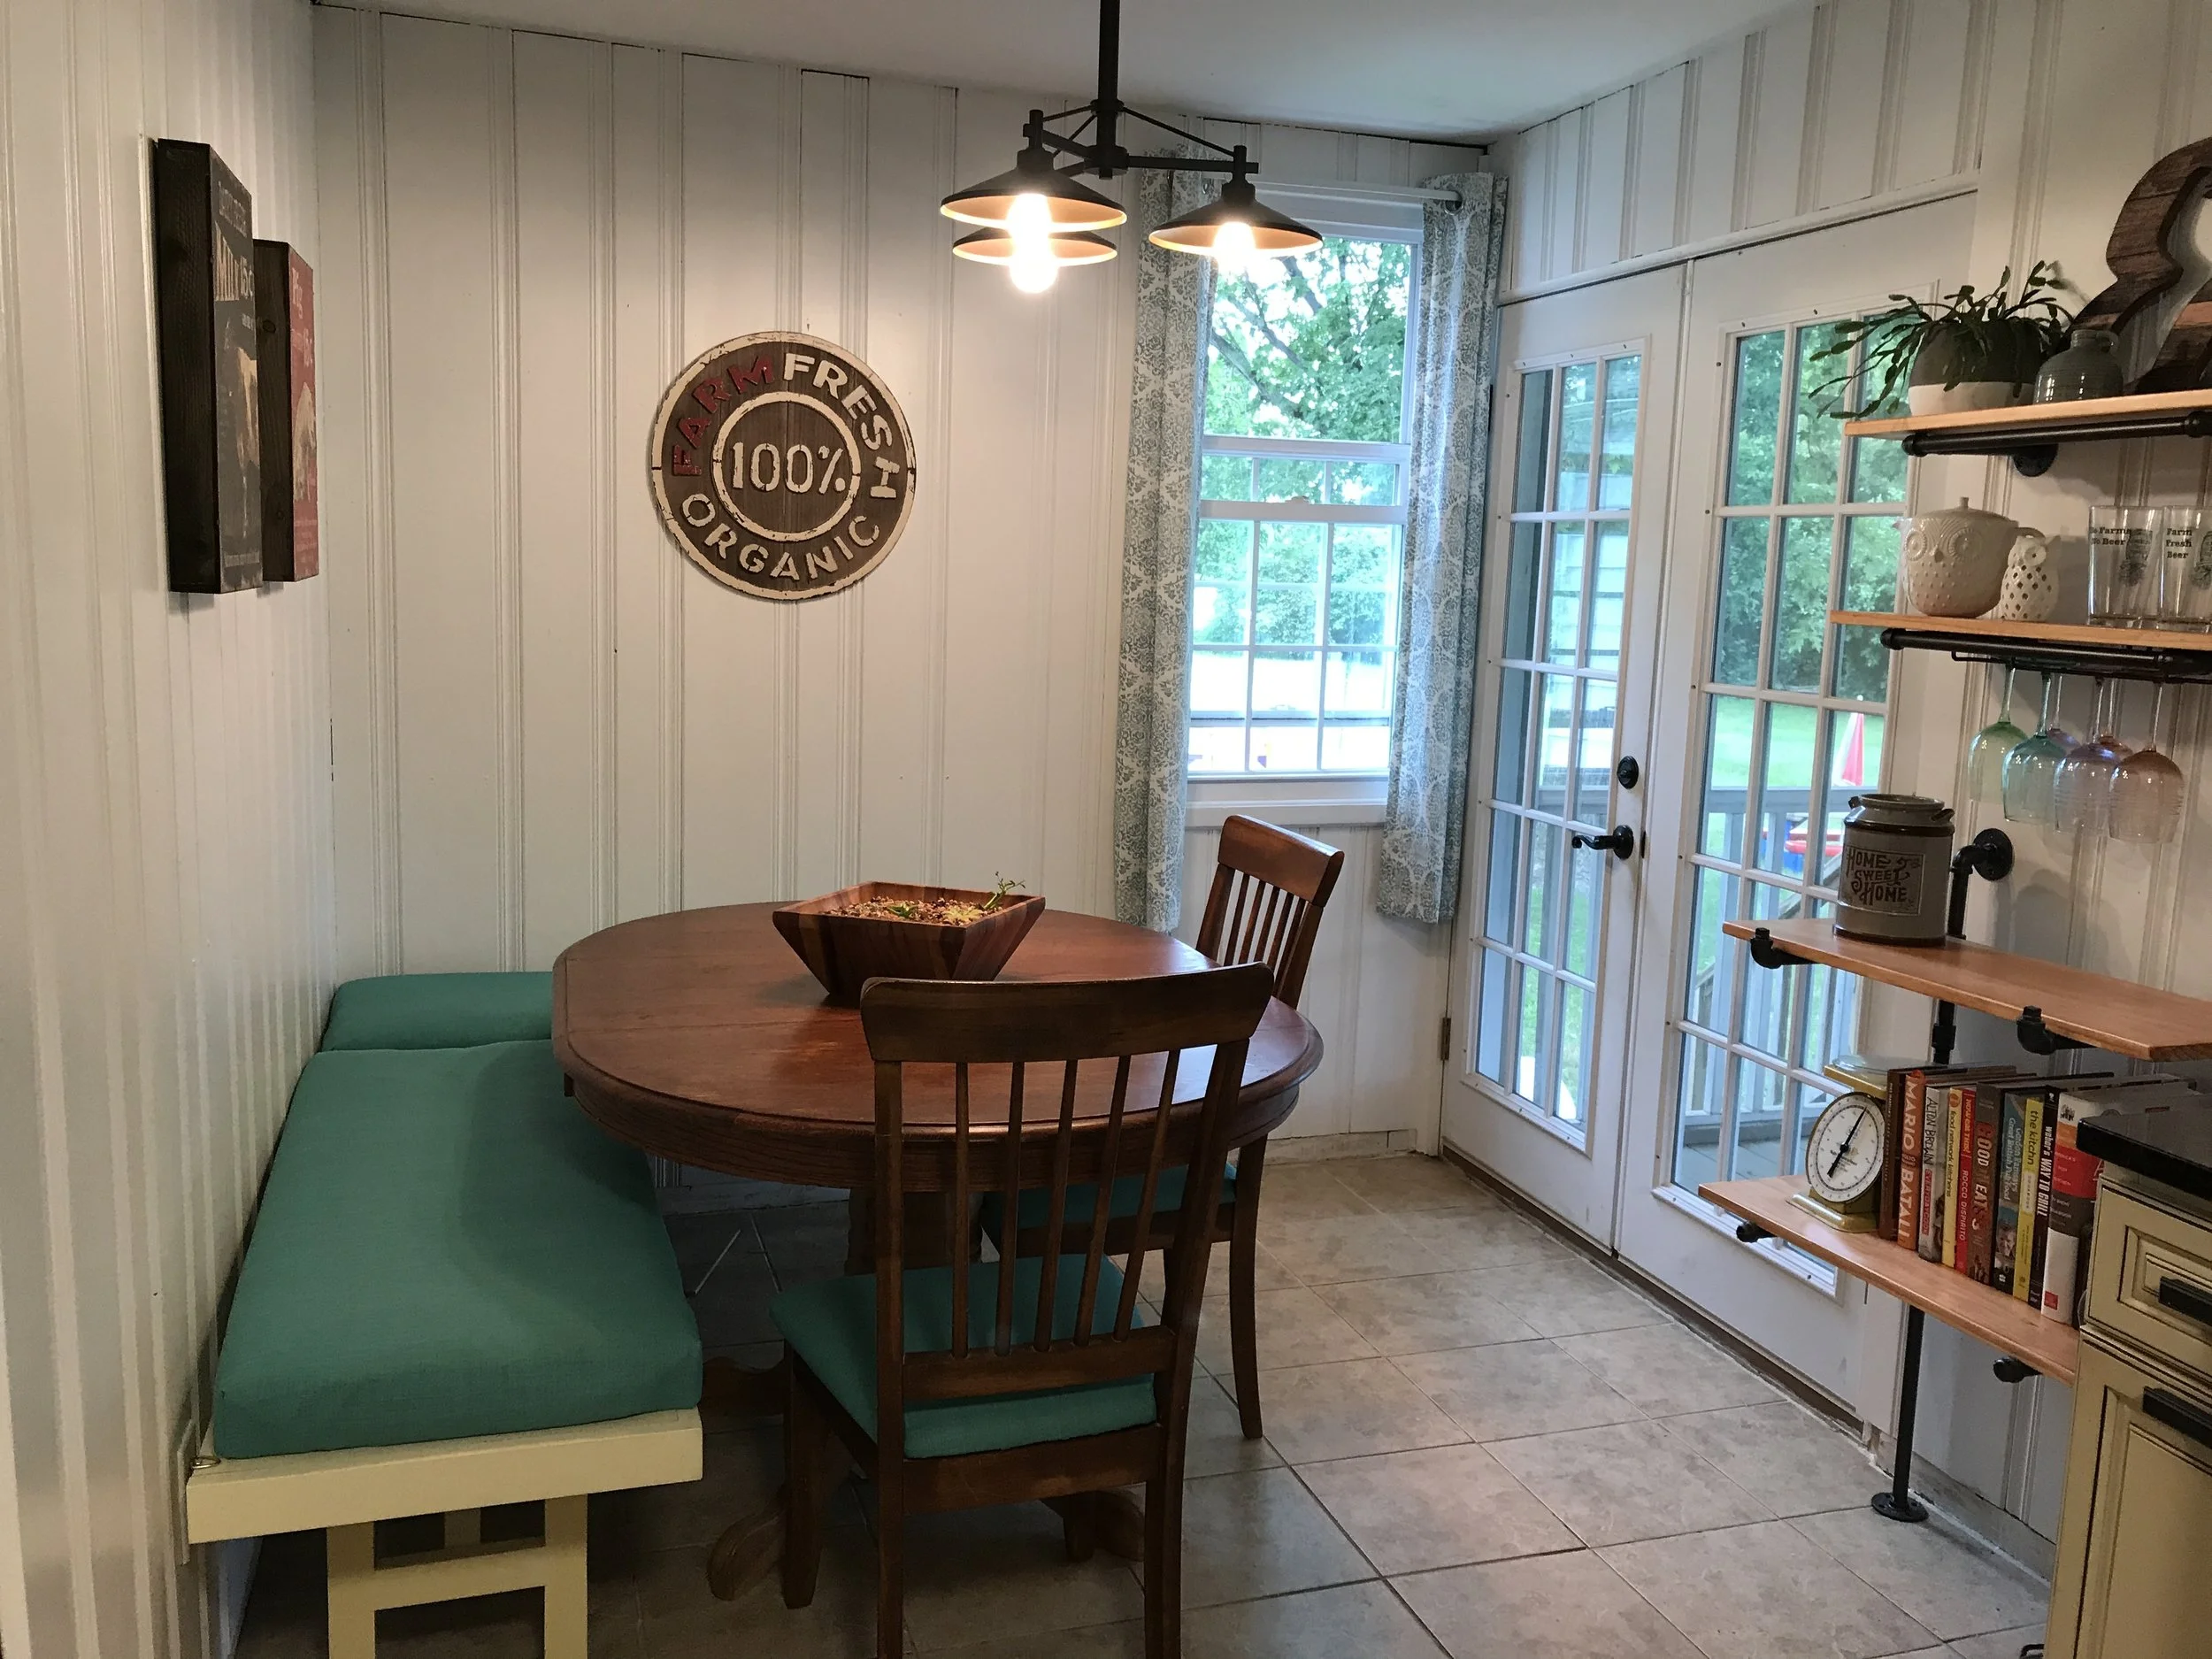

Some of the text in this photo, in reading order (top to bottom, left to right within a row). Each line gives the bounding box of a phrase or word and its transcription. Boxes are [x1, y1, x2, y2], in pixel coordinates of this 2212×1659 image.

[672, 353, 900, 499] FARM FRESH
[733, 442, 846, 495] 100%
[681, 493, 879, 580] ORGANIC
[2166, 527, 2193, 536] Farm
[2167, 550, 2188, 559] Beer
[1846, 847, 1891, 878] HOME
[1851, 869, 1910, 894] SWEET
[1859, 885, 1907, 906] HOME
[1904, 1081, 1918, 1150] MARIO
[1923, 1097, 1939, 1166] ALTON BROWN
[2027, 1110, 2039, 1165] the kitchn
[2040, 1157, 2053, 1179] WAY
[2039, 1179, 2050, 1192] TO
[1898, 1168, 1914, 1238] BATALI
[2037, 1192, 2049, 1217] GRILL
